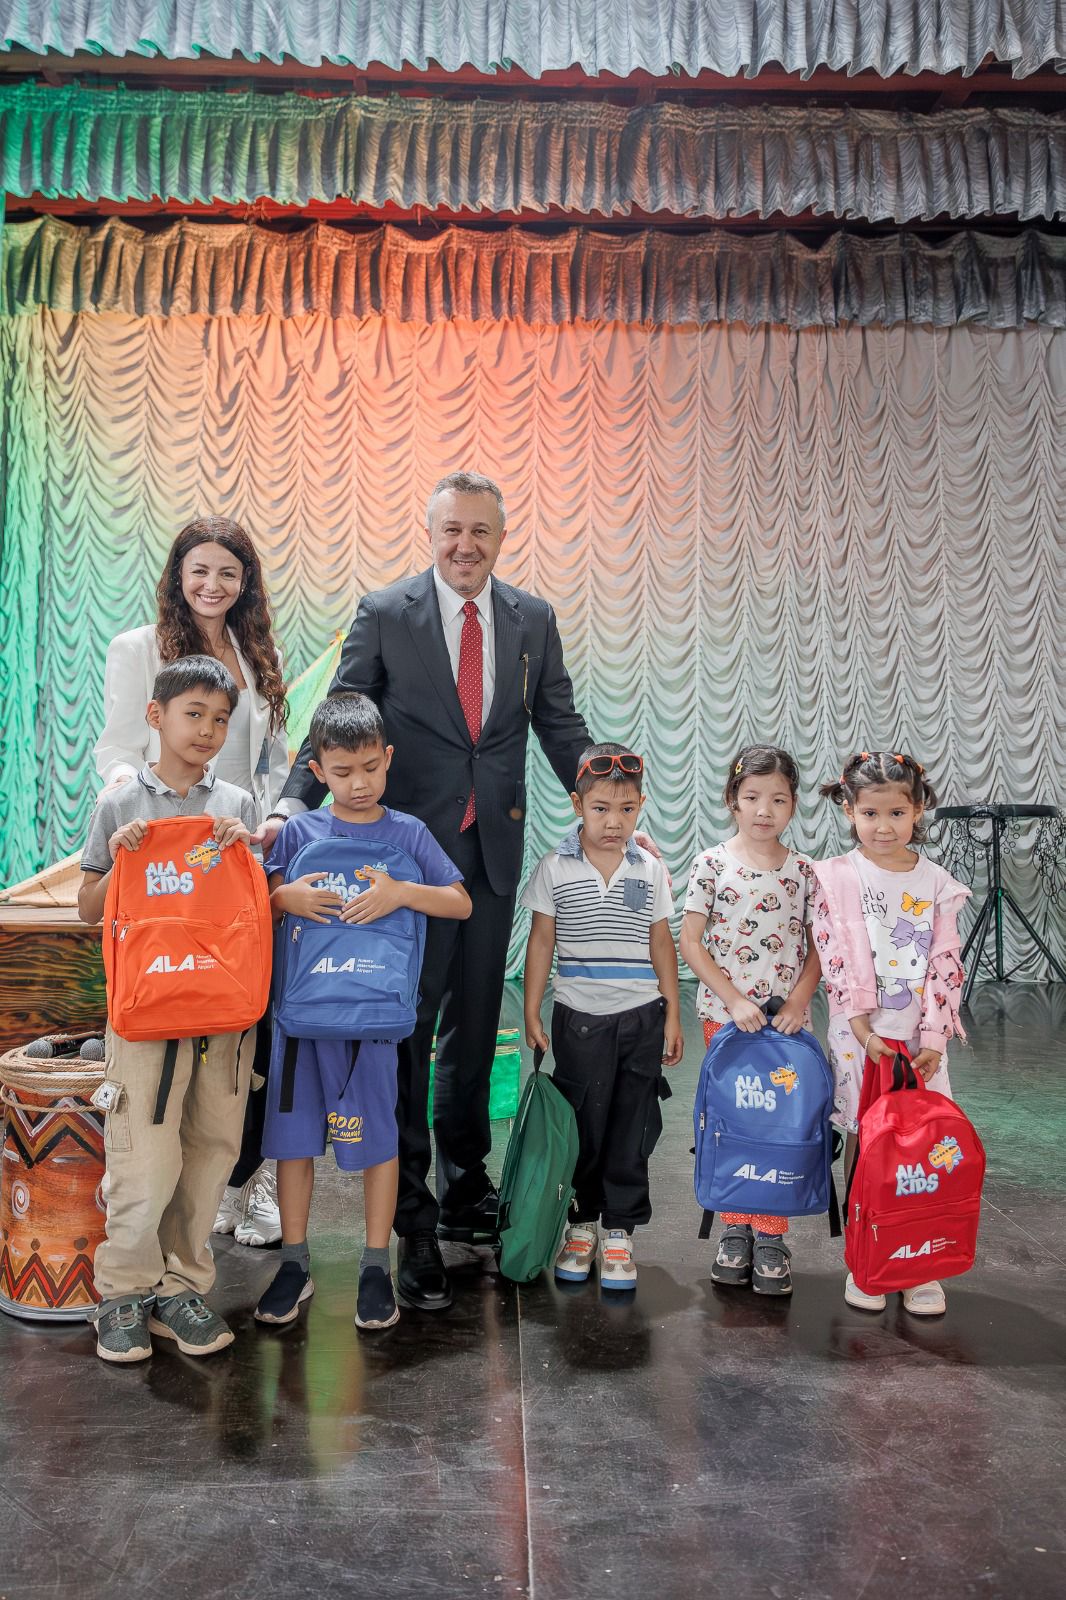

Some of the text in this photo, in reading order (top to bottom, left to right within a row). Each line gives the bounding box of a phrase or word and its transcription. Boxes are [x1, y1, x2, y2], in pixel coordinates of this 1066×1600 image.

[145, 860, 178, 877] ALA
[146, 871, 194, 897] KIDS
[145, 954, 195, 974] ALA
[310, 957, 356, 974] ALA
[735, 1074, 763, 1092] ALA
[735, 1087, 777, 1113] KIDS
[732, 1163, 778, 1184] ALA
[896, 1163, 926, 1180] ALA
[896, 1173, 939, 1197] KIDS
[888, 1240, 931, 1259] ALA
